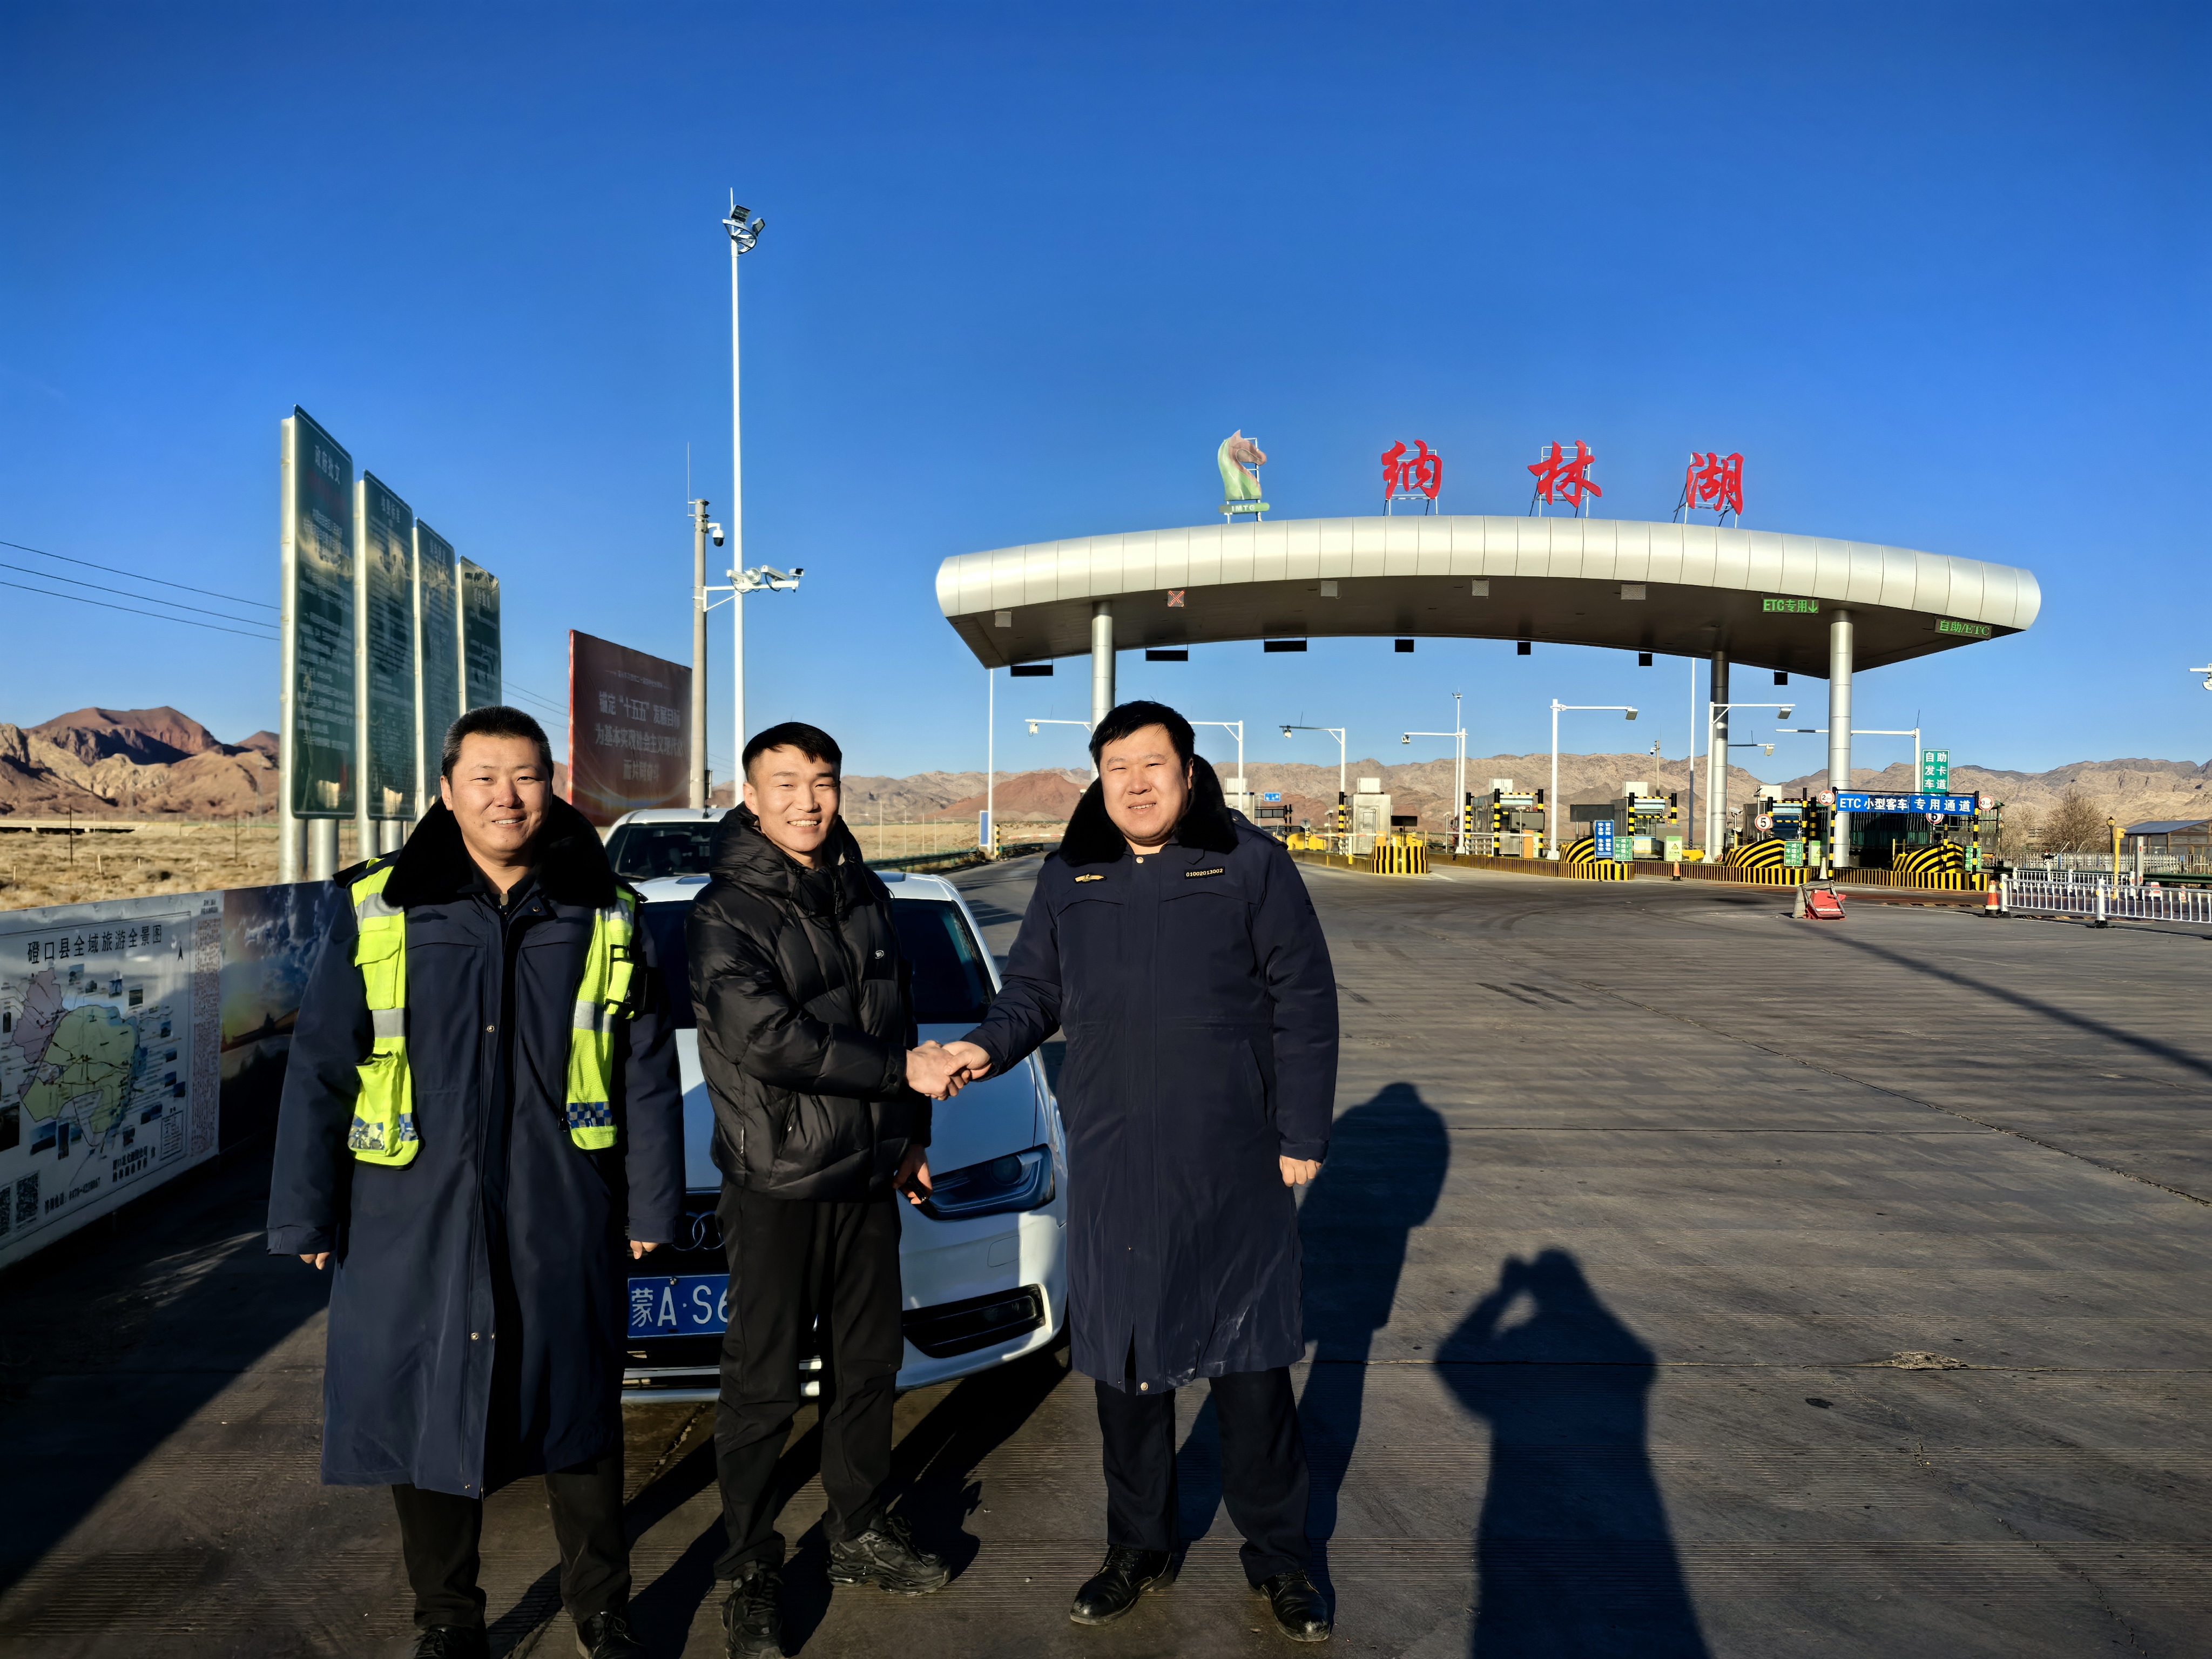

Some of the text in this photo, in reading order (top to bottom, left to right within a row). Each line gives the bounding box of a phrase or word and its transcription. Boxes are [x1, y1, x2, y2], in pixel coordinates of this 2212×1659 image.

[1381, 439, 1744, 516] 纳林湖
[1939, 620, 1991, 636] 自助/ETC
[1925, 752, 1947, 763] 自助
[1924, 765, 1947, 776] 发卡
[1924, 779, 1946, 790] 车道
[1839, 798, 1971, 812] ETC 小型客车 专用通道
[1760, 817, 1766, 827] 5
[28, 925, 162, 965] 磴口县全域旅游全景图
